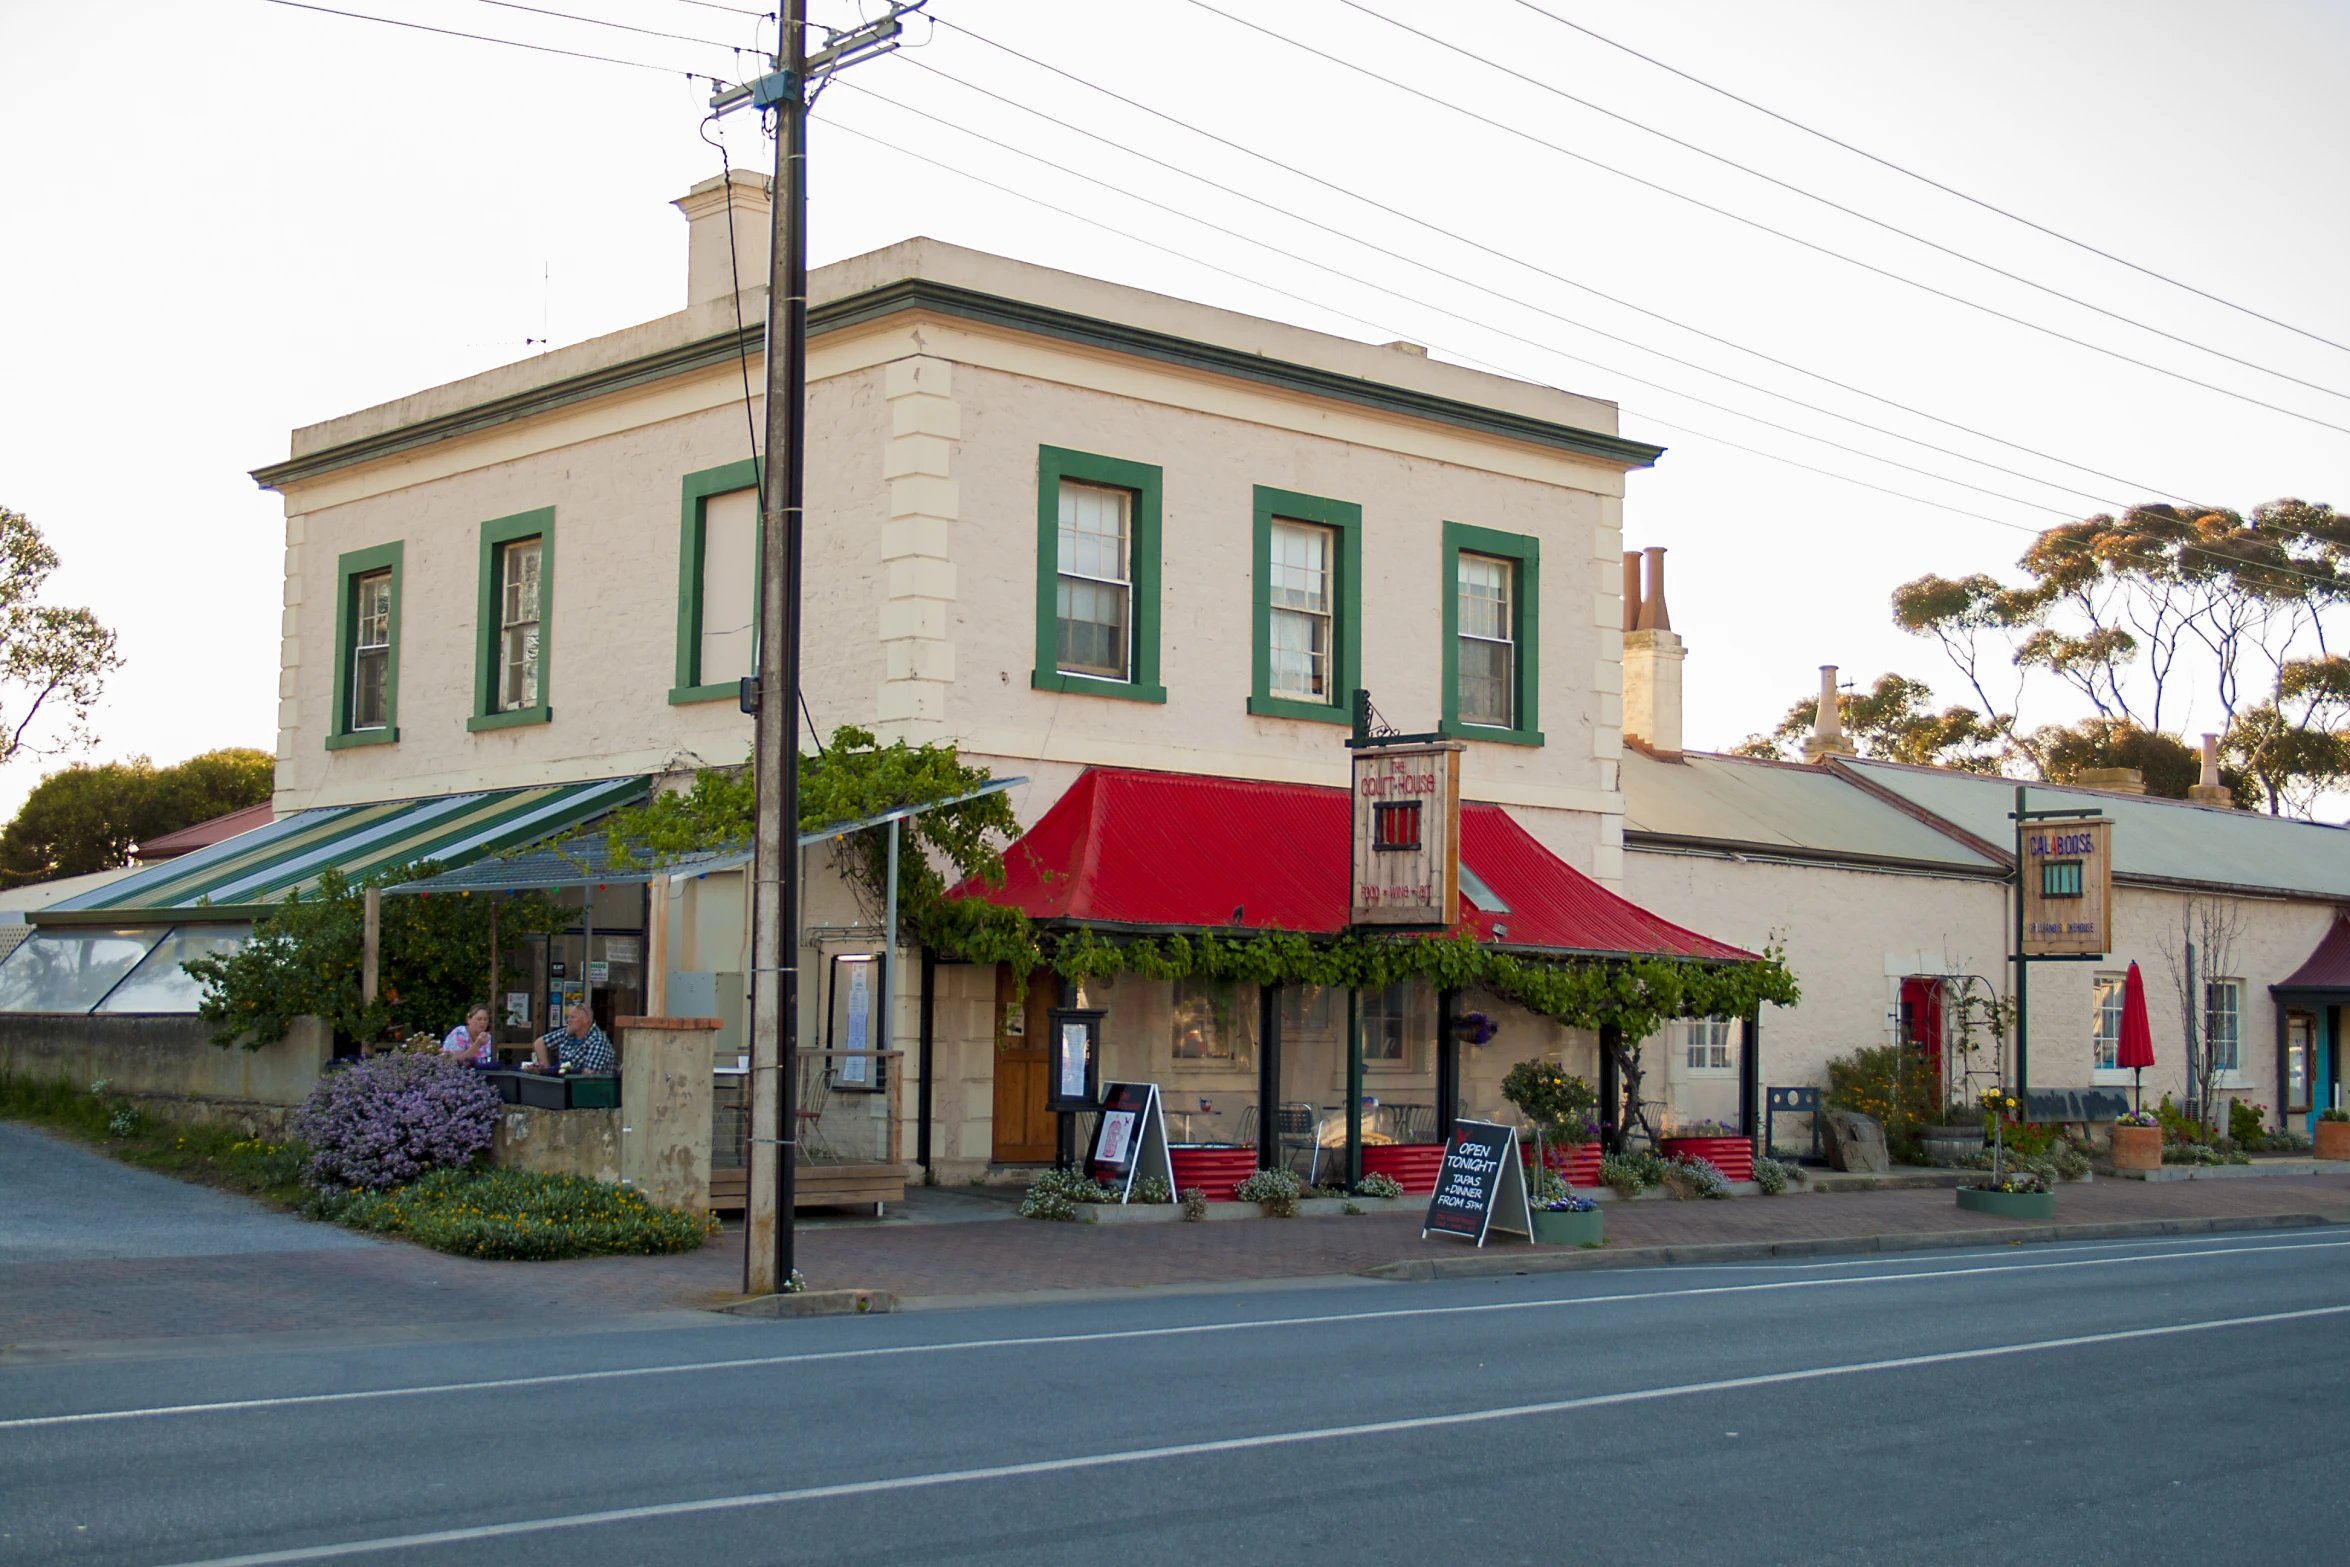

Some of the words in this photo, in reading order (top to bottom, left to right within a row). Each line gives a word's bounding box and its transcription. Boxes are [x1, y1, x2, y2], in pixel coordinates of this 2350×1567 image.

[2029, 833, 2092, 856] CALABOOSE
[1459, 1142, 1491, 1157] OPEN
[1447, 1155, 1497, 1173] TONIGHT
[1453, 1174, 1482, 1186] TAPAS
[1437, 1194, 1464, 1207] FROM
